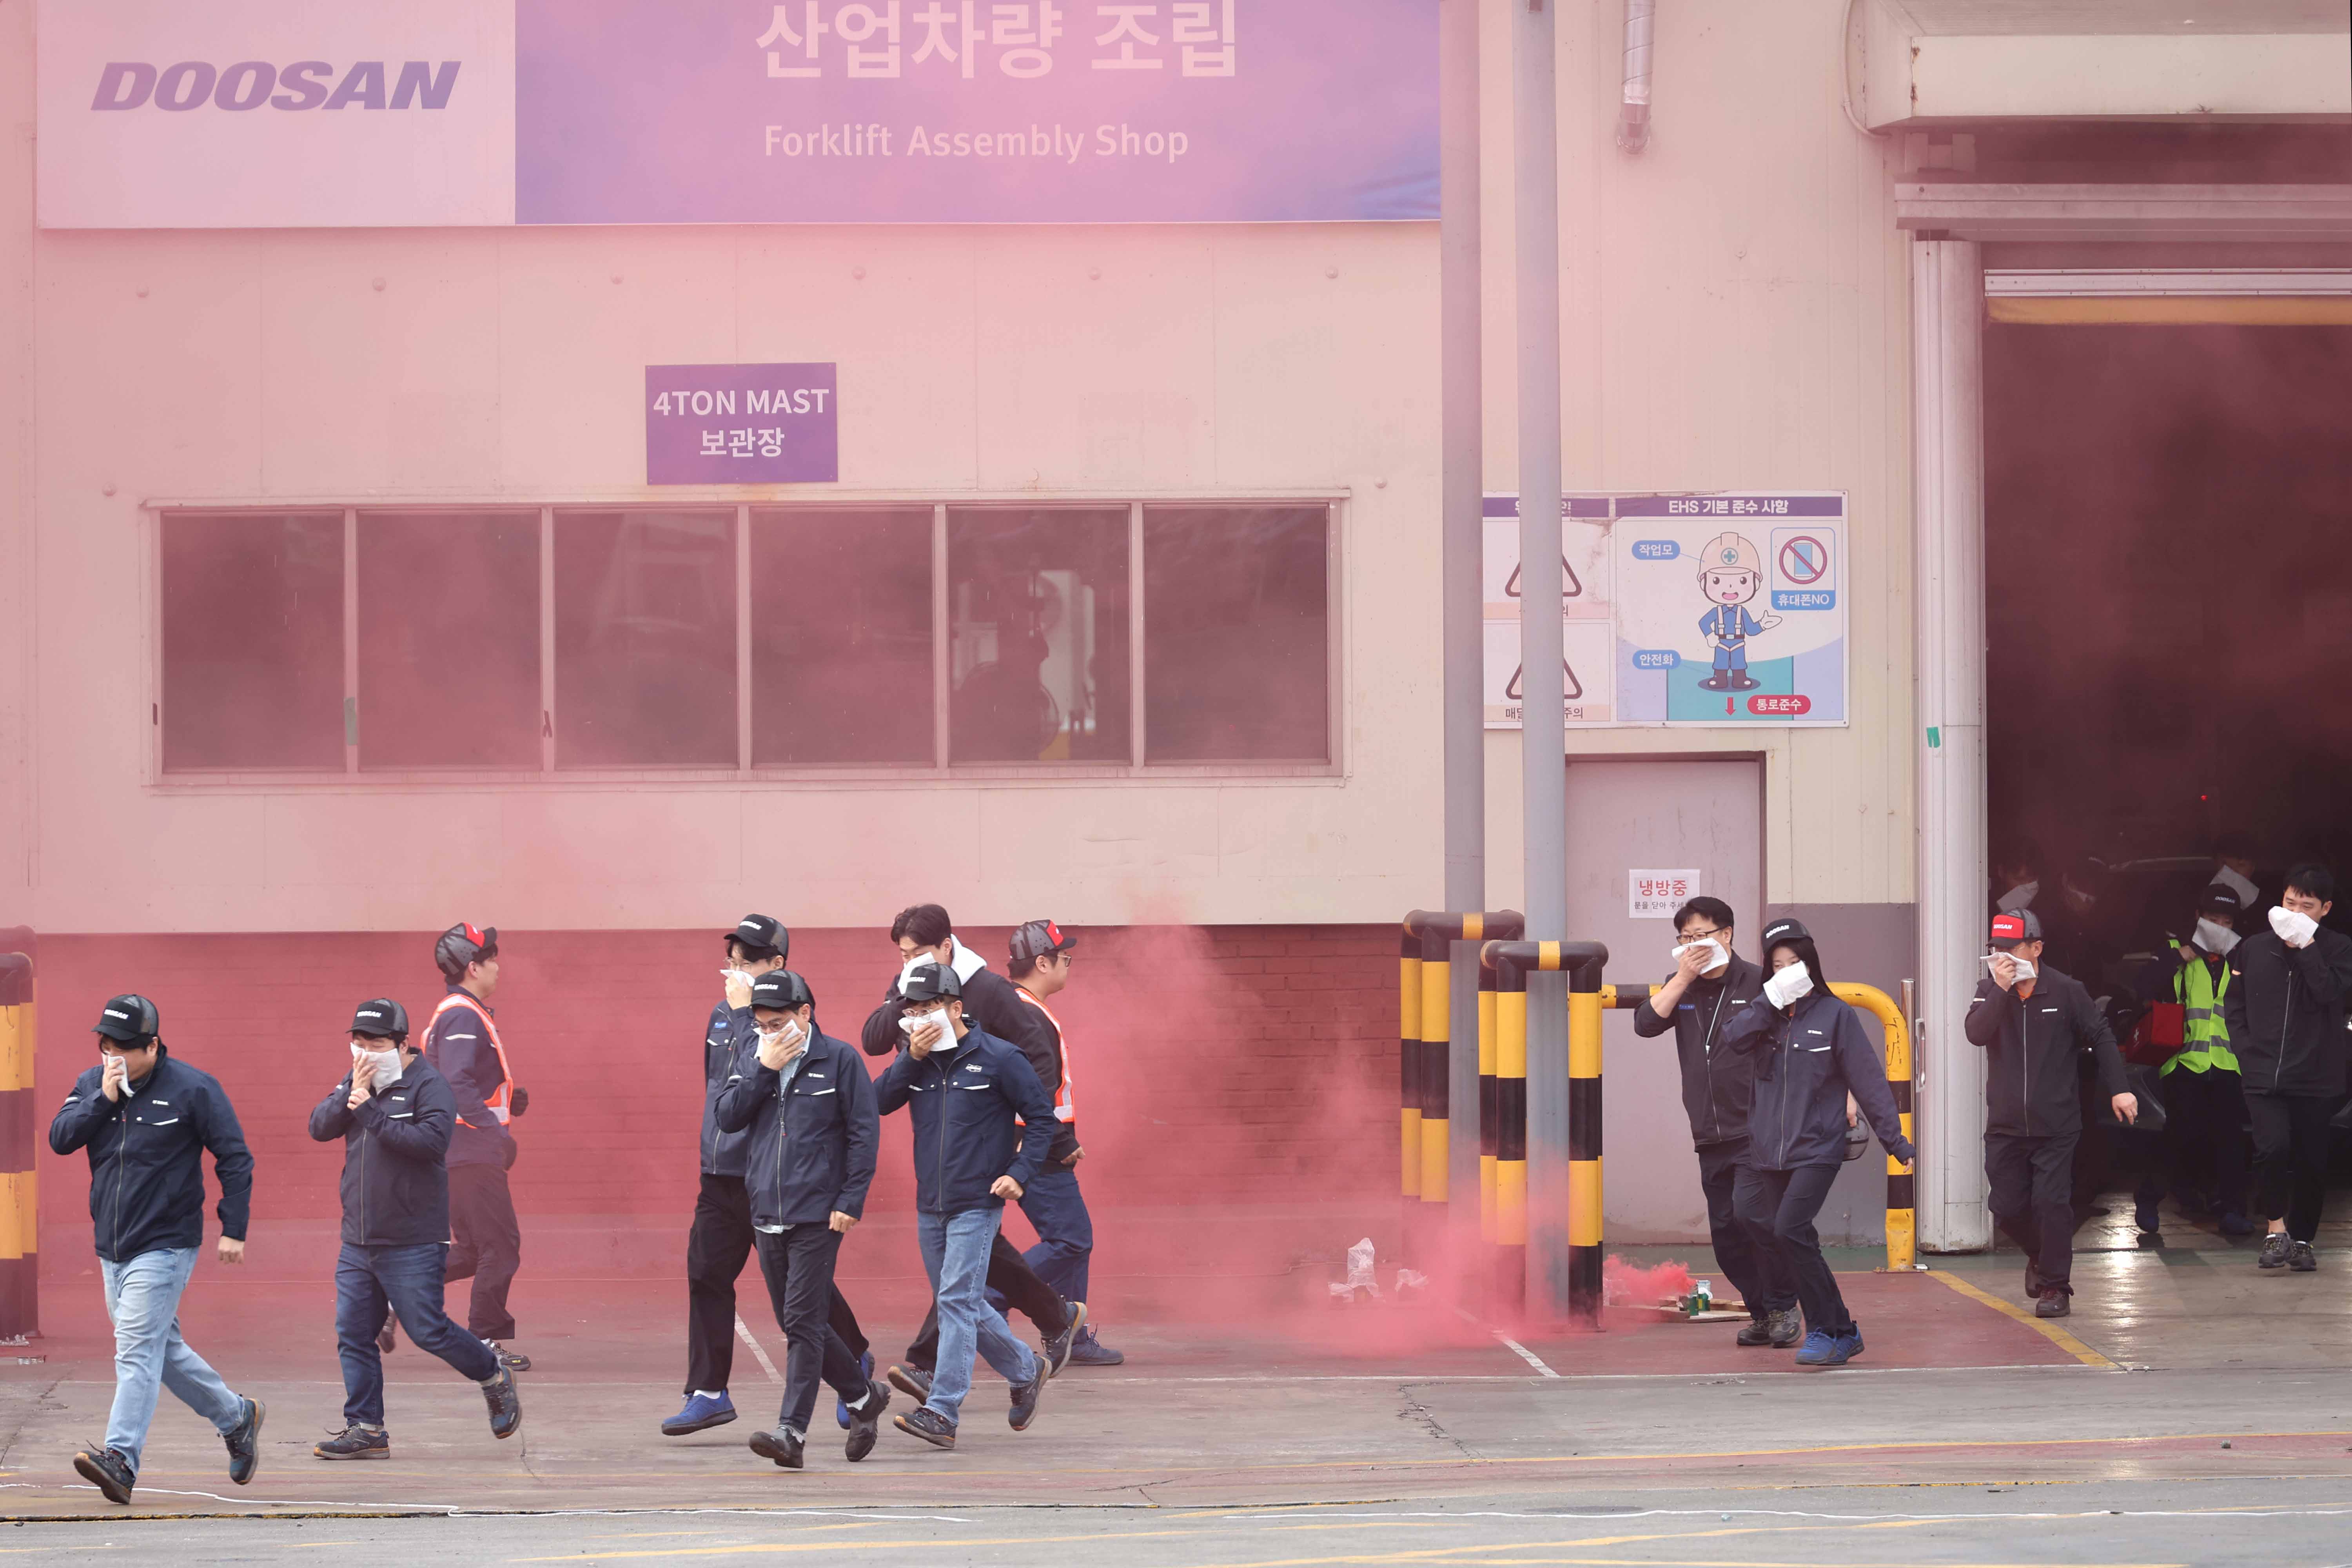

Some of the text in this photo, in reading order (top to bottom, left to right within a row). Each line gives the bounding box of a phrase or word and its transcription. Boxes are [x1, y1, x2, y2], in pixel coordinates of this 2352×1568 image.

[755, 0, 1235, 78] 산업차량 조립
[90, 60, 462, 111] DOOSAN
[765, 123, 1189, 165] Forklift Assembly Shop
[653, 388, 829, 416] 4TON MAST
[700, 427, 785, 457] 보관장
[1669, 499, 1789, 514] EHS 기본 준수 사항
[1639, 544, 1673, 557] 작업모
[1777, 593, 1830, 607] 휴대폰NO
[1639, 653, 1674, 666] 안전화
[1756, 698, 1802, 711] 통로준수
[1639, 879, 1687, 897] 냉방중
[1634, 901, 1685, 909] 문을 닫아 주세
[2214, 895, 2236, 904] DOOSAN
[1766, 924, 1789, 939] DOOSAN
